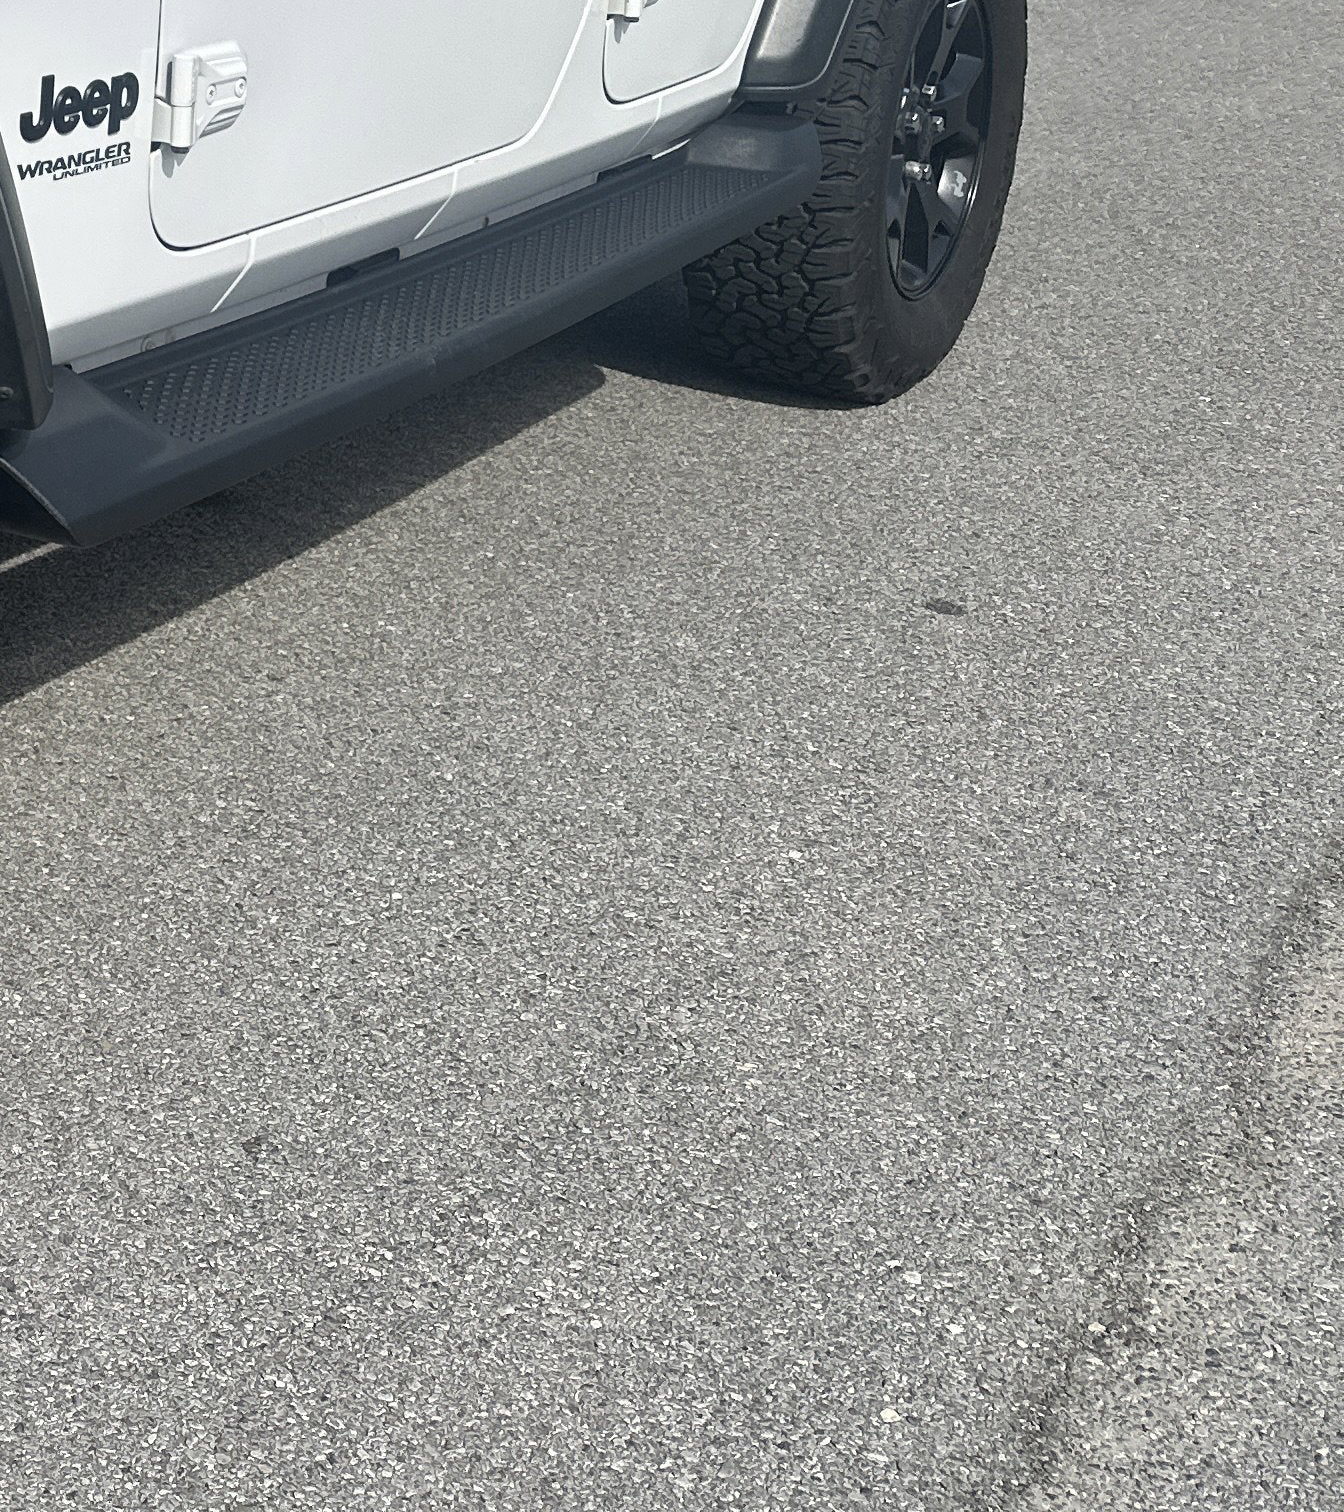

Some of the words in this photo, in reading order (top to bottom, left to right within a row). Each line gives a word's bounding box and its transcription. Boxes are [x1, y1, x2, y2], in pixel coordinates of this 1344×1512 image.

[20, 72, 139, 143] Jeep
[17, 141, 131, 180] WRANGLER
[53, 156, 131, 181] UNLIMITED
